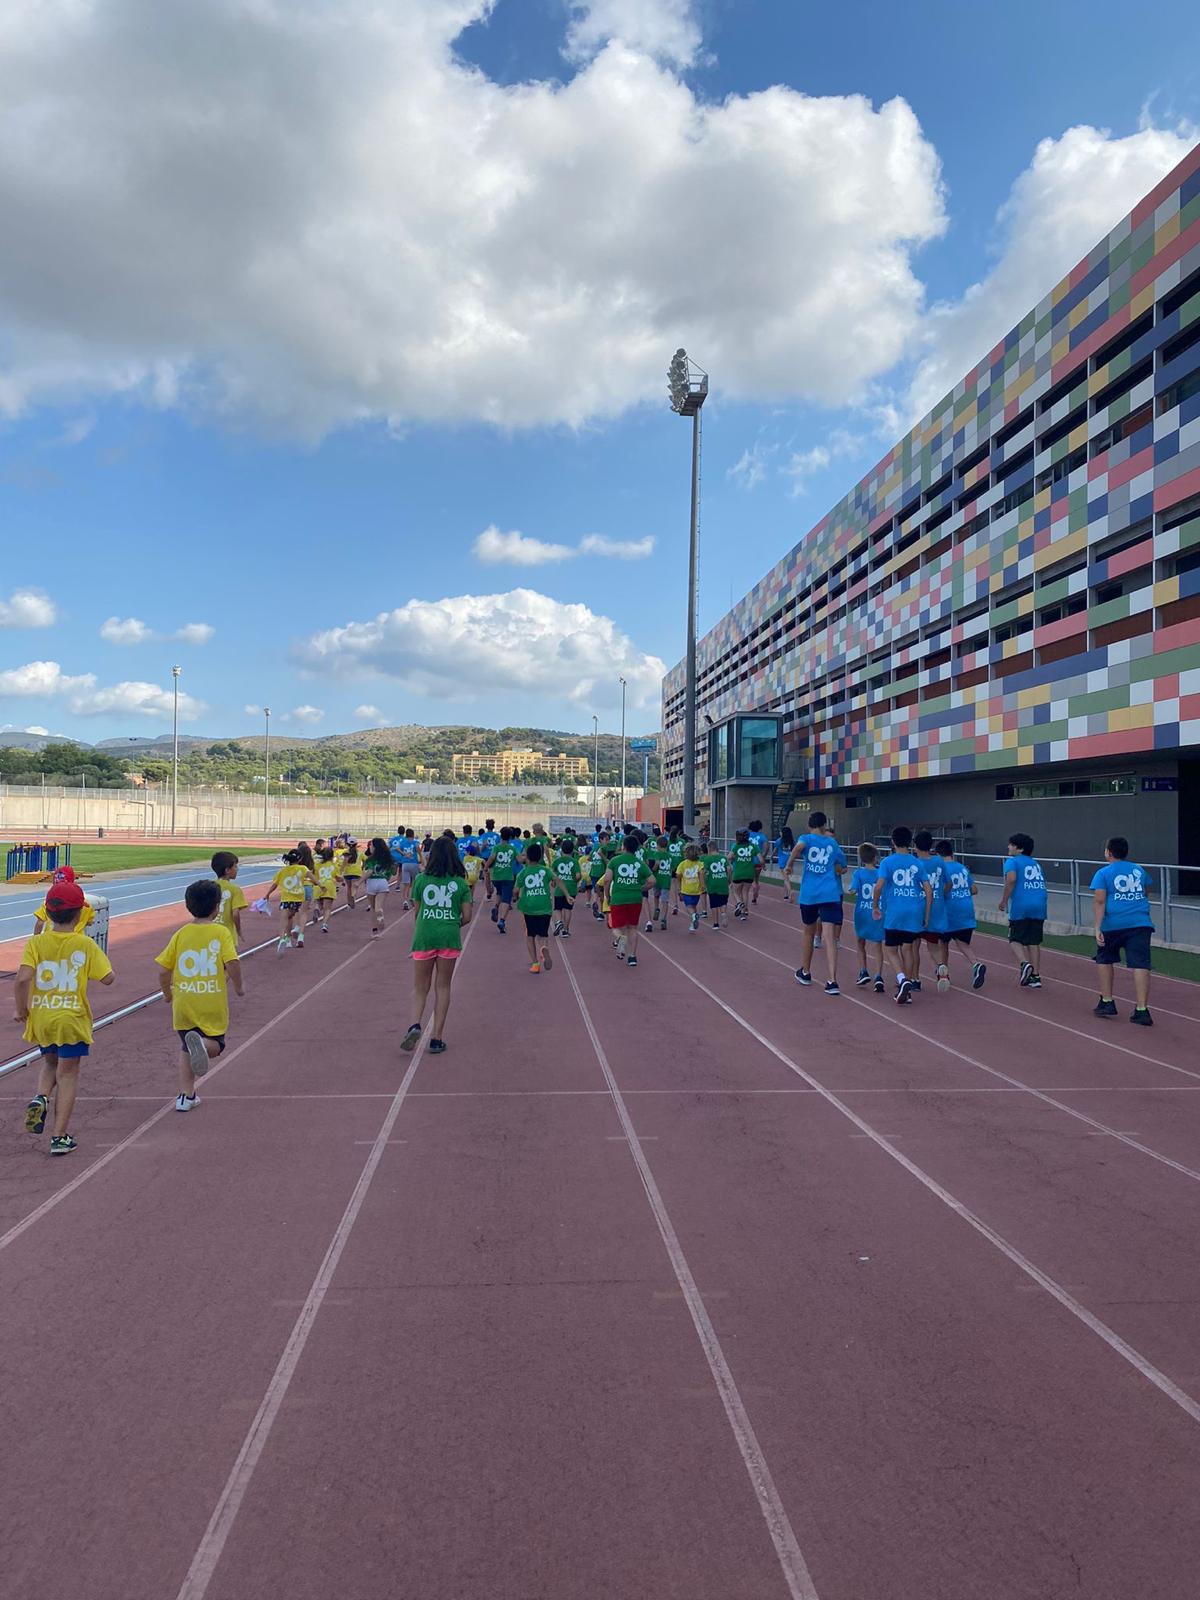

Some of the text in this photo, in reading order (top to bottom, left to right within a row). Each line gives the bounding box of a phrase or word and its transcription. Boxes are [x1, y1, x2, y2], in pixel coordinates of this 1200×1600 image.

[808, 845, 833, 865] OK
[524, 869, 546, 888] OK
[617, 861, 641, 878] OK
[892, 865, 918, 887] OK
[1113, 868, 1143, 893] OK
[422, 881, 458, 908] OK
[526, 887, 547, 897] PADEL
[422, 908, 455, 920] PADEL
[178, 939, 221, 978] OK
[35, 950, 86, 992] OK
[179, 979, 222, 993] PADEL
[31, 994, 81, 1010] PADEL
